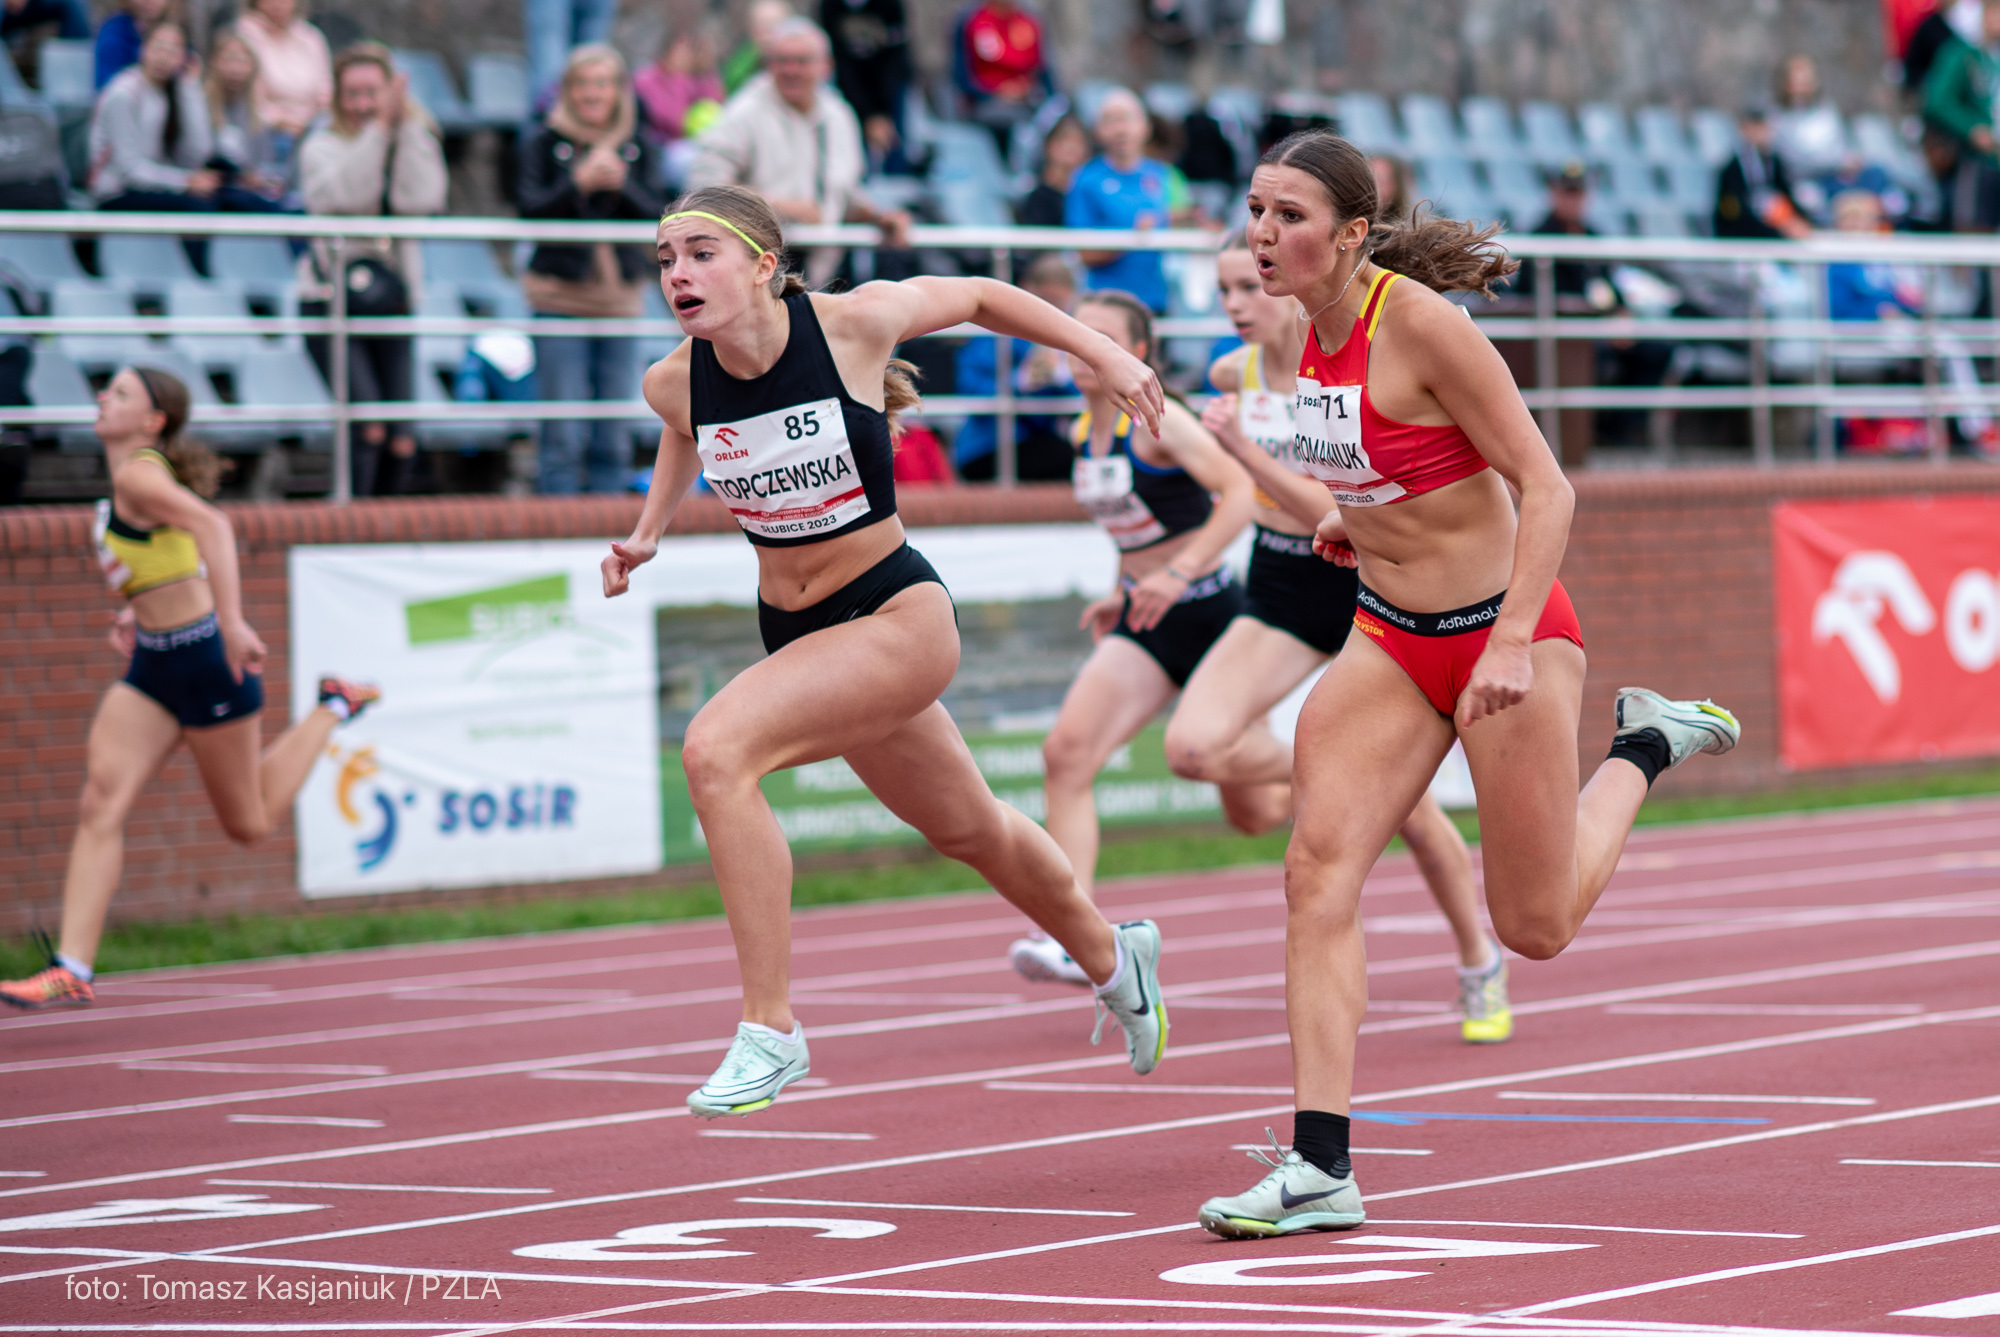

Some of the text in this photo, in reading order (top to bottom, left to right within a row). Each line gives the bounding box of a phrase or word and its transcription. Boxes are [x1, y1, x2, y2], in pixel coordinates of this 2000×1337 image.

[1320, 394, 1348, 420] 71
[784, 410, 820, 440] 85
[715, 449, 749, 462] ORLEN
[1295, 433, 1366, 470] ROMANIUK
[712, 454, 851, 500] TOPCZEWSKA
[761, 514, 837, 534] SŁUBICE 2023
[1437, 603, 1503, 631] AdRunaLi
[511, 1216, 899, 1261] 3
[1158, 1235, 1604, 1287] 2
